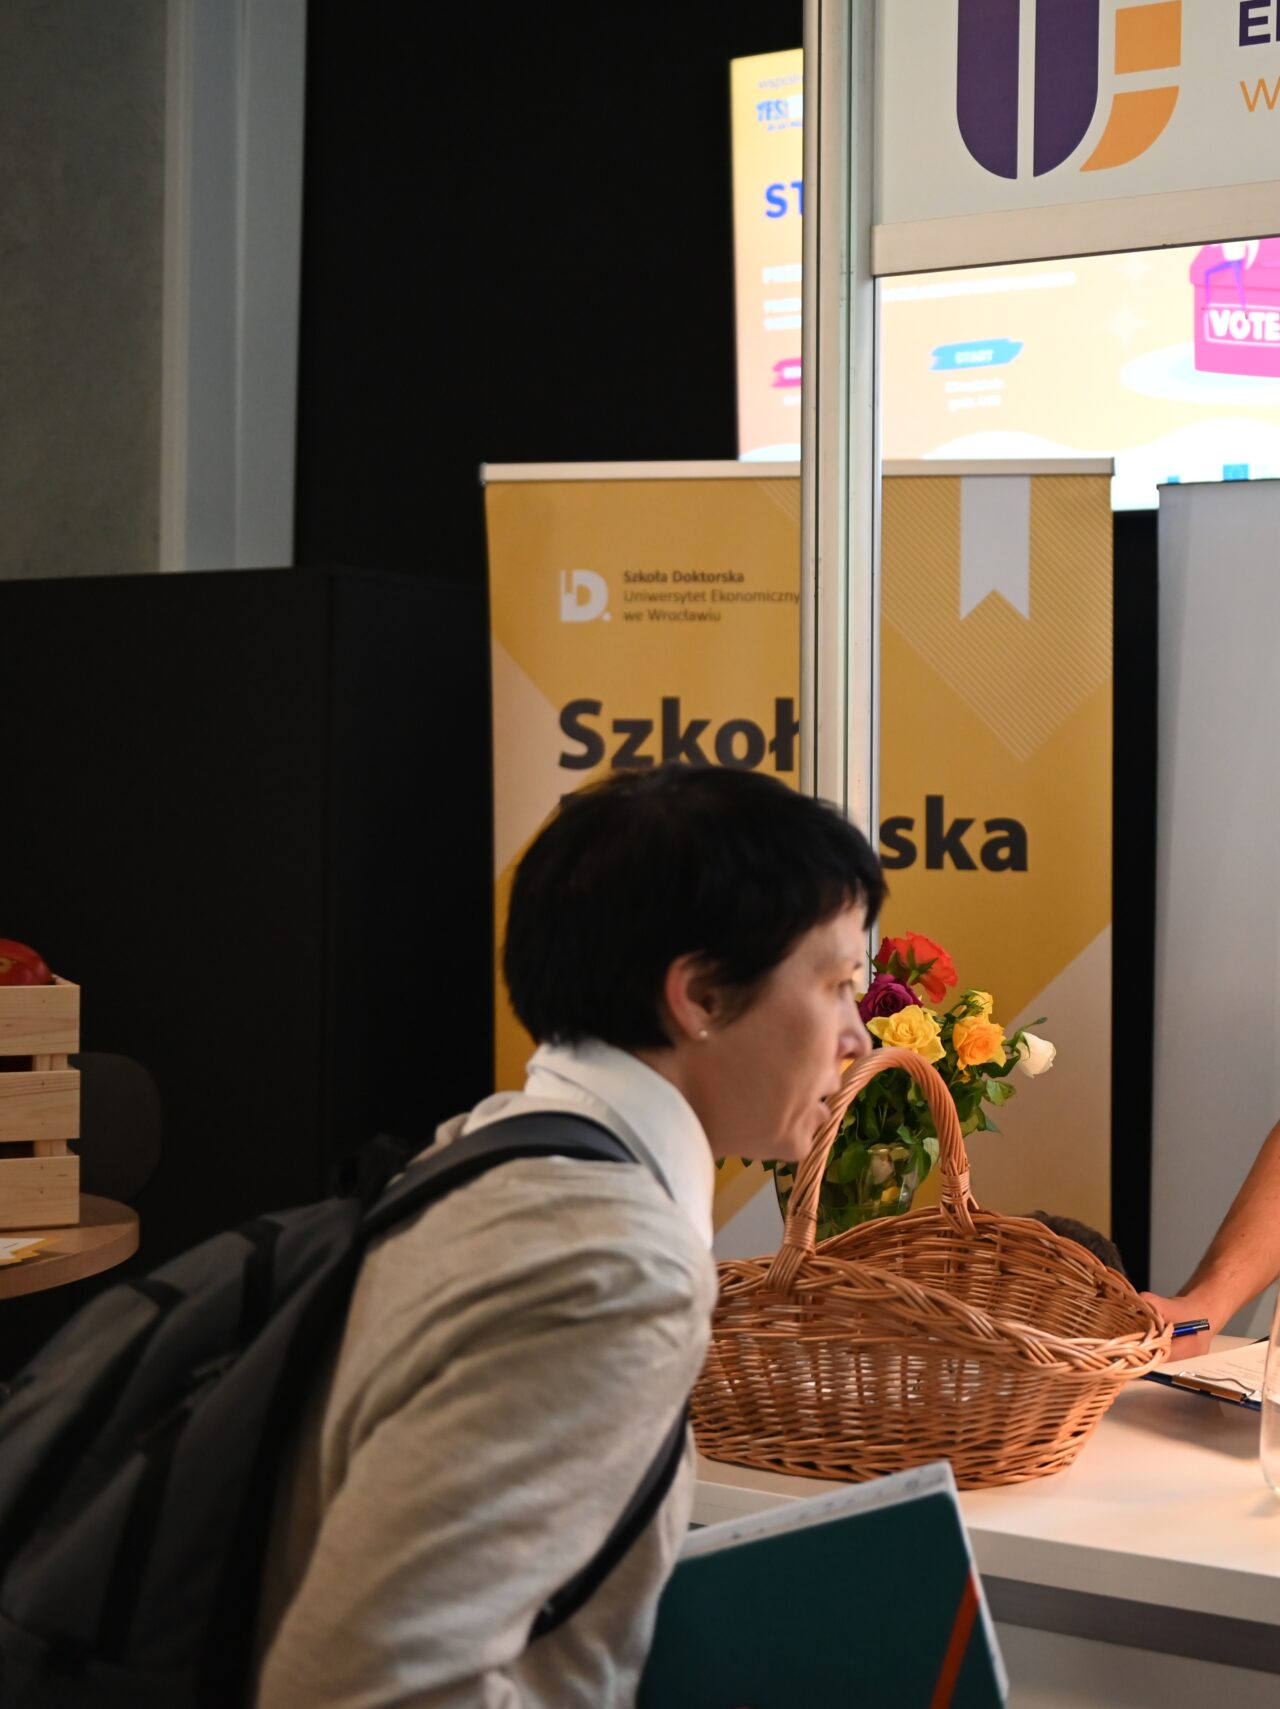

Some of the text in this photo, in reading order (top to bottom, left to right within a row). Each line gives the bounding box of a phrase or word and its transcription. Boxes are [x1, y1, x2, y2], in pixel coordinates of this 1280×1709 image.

[624, 570, 745, 584] Szkoła Doktorska
[623, 590, 800, 605] Uniwersytet Ekonomiczny
[624, 609, 722, 622] we Wrocławiu
[558, 697, 800, 772] Szkoł
[879, 795, 1028, 872] ska
